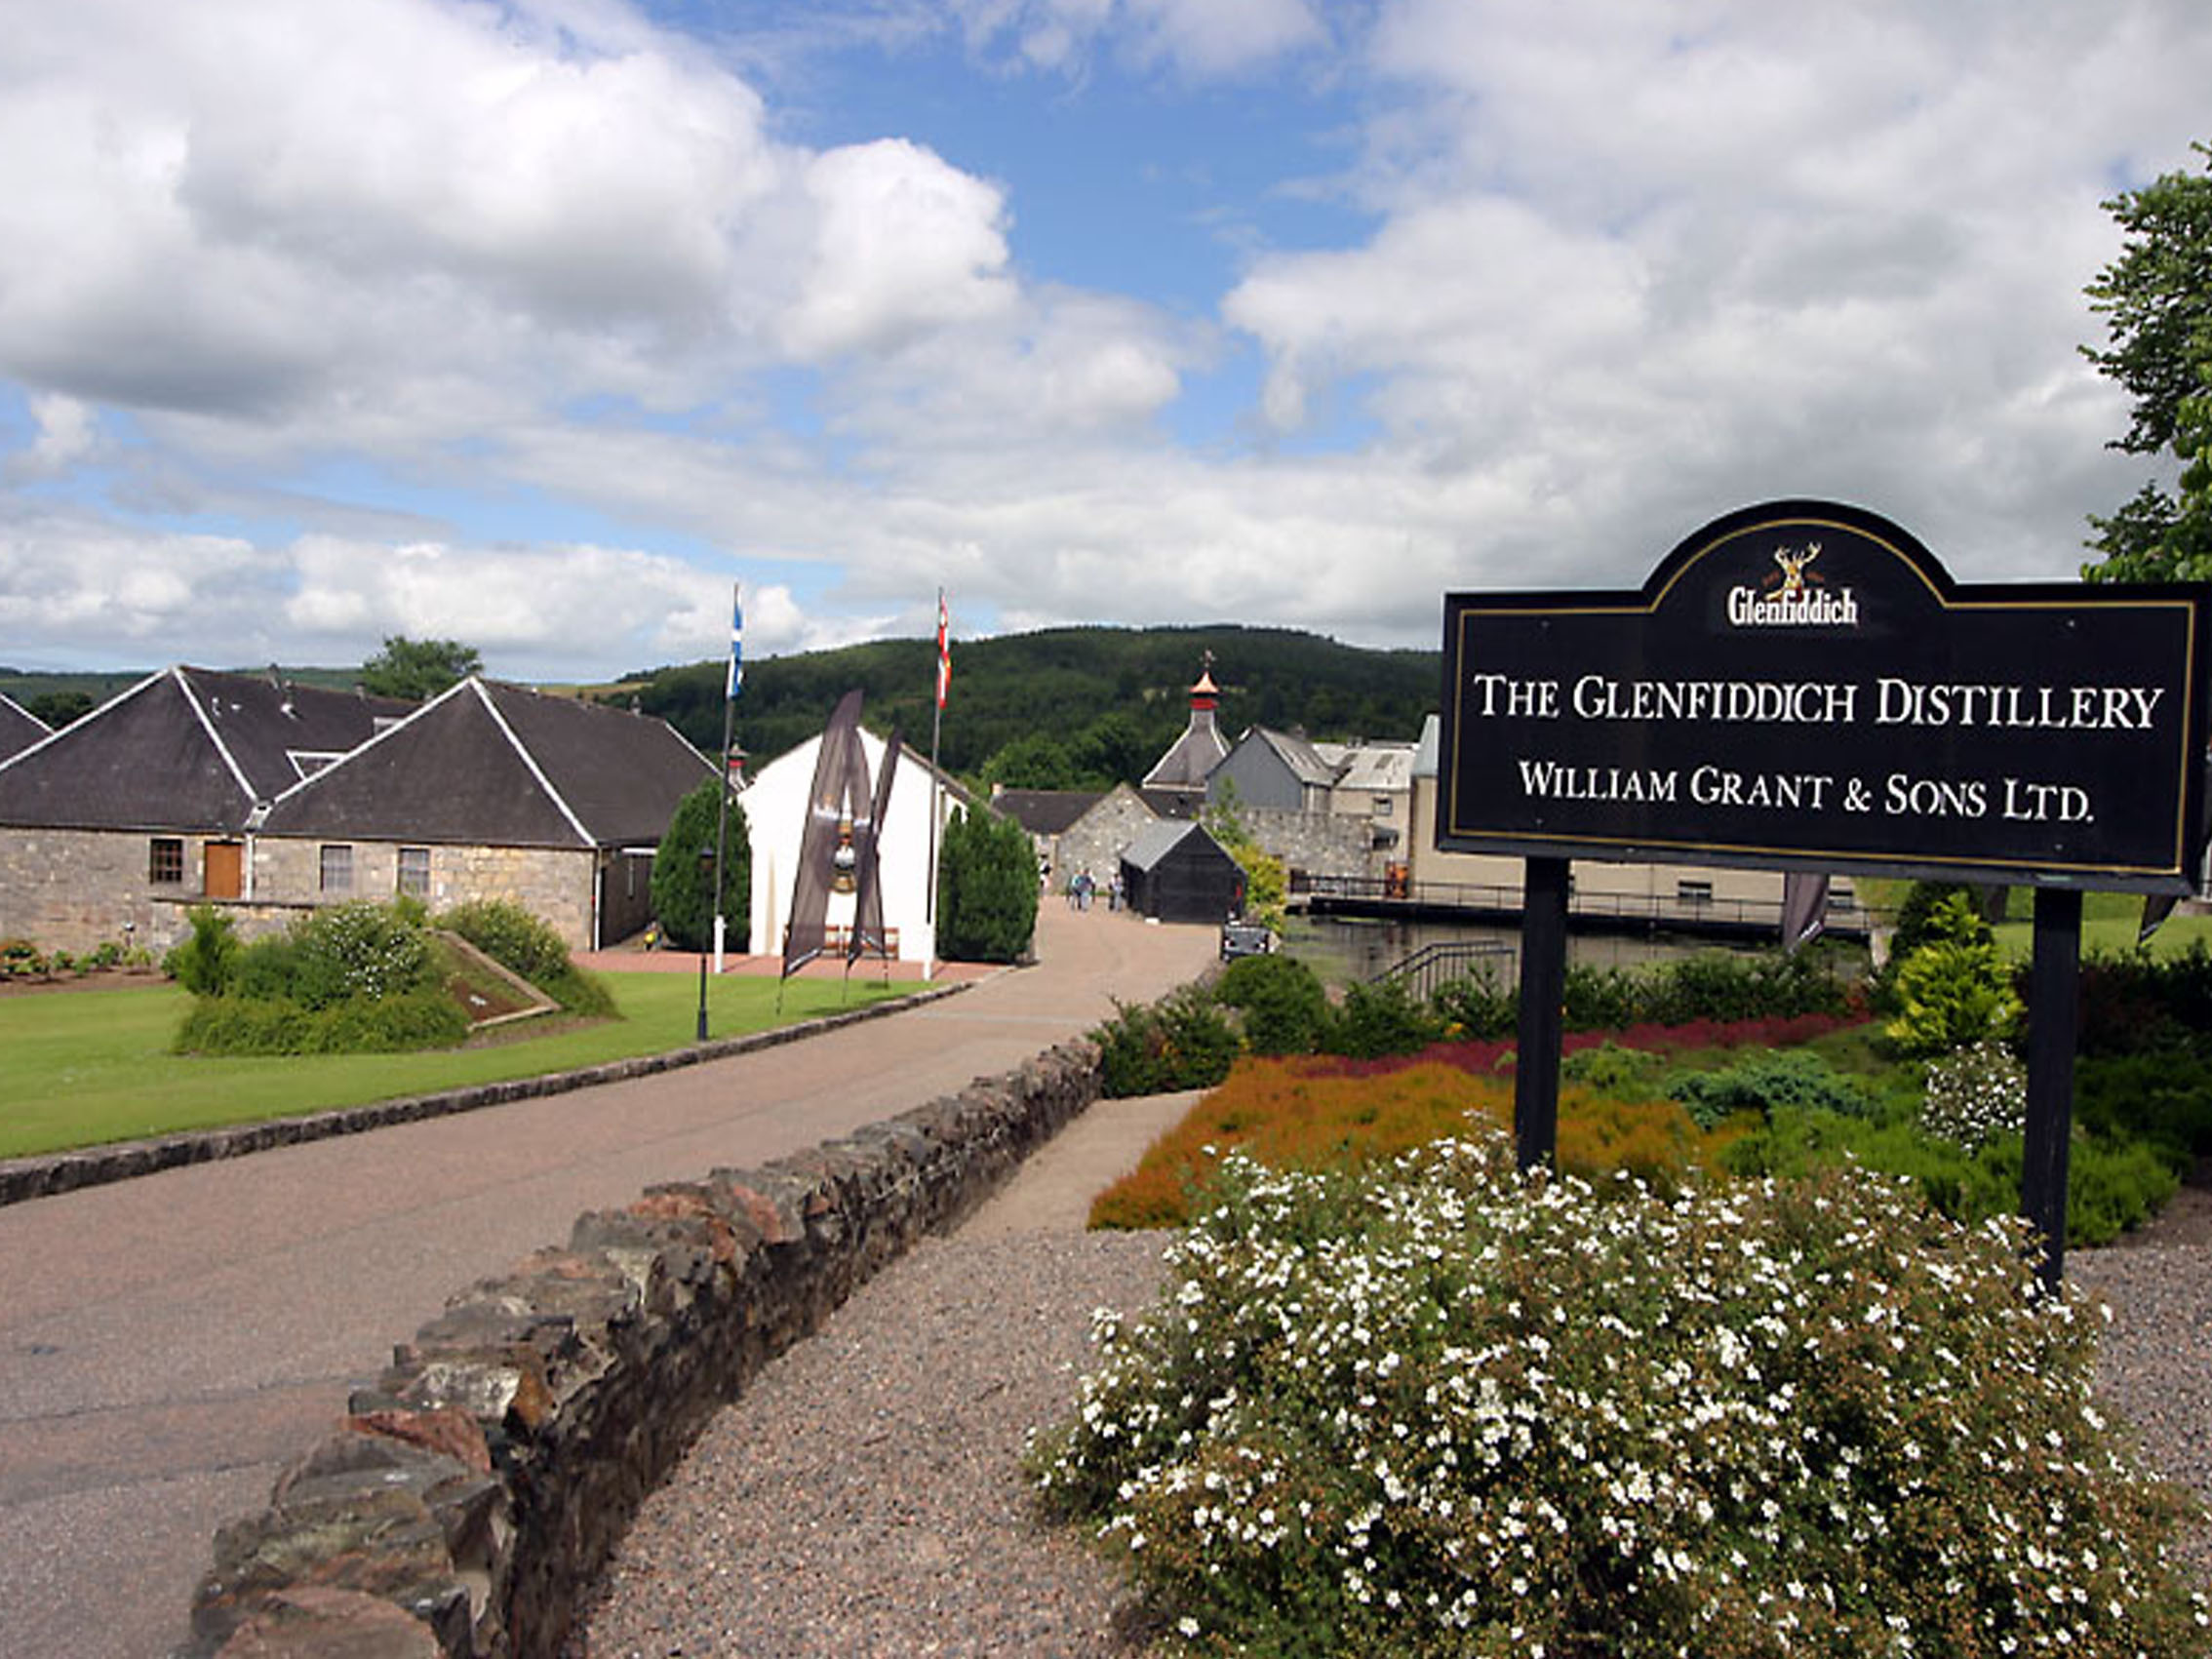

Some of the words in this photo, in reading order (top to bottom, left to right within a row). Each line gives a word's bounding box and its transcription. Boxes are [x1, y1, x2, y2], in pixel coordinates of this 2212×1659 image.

[1727, 586, 1858, 625] Glenfiddich
[1474, 674, 1560, 718] THE
[1573, 675, 1858, 723] GLENFIDDICH
[1876, 679, 2164, 729] DISTILLERY
[1519, 761, 1678, 802] WILLIAM
[1690, 765, 1834, 809] GRANT
[1843, 778, 1872, 813] &
[1884, 773, 1987, 817] SONS
[2003, 778, 2094, 822] LTD.
